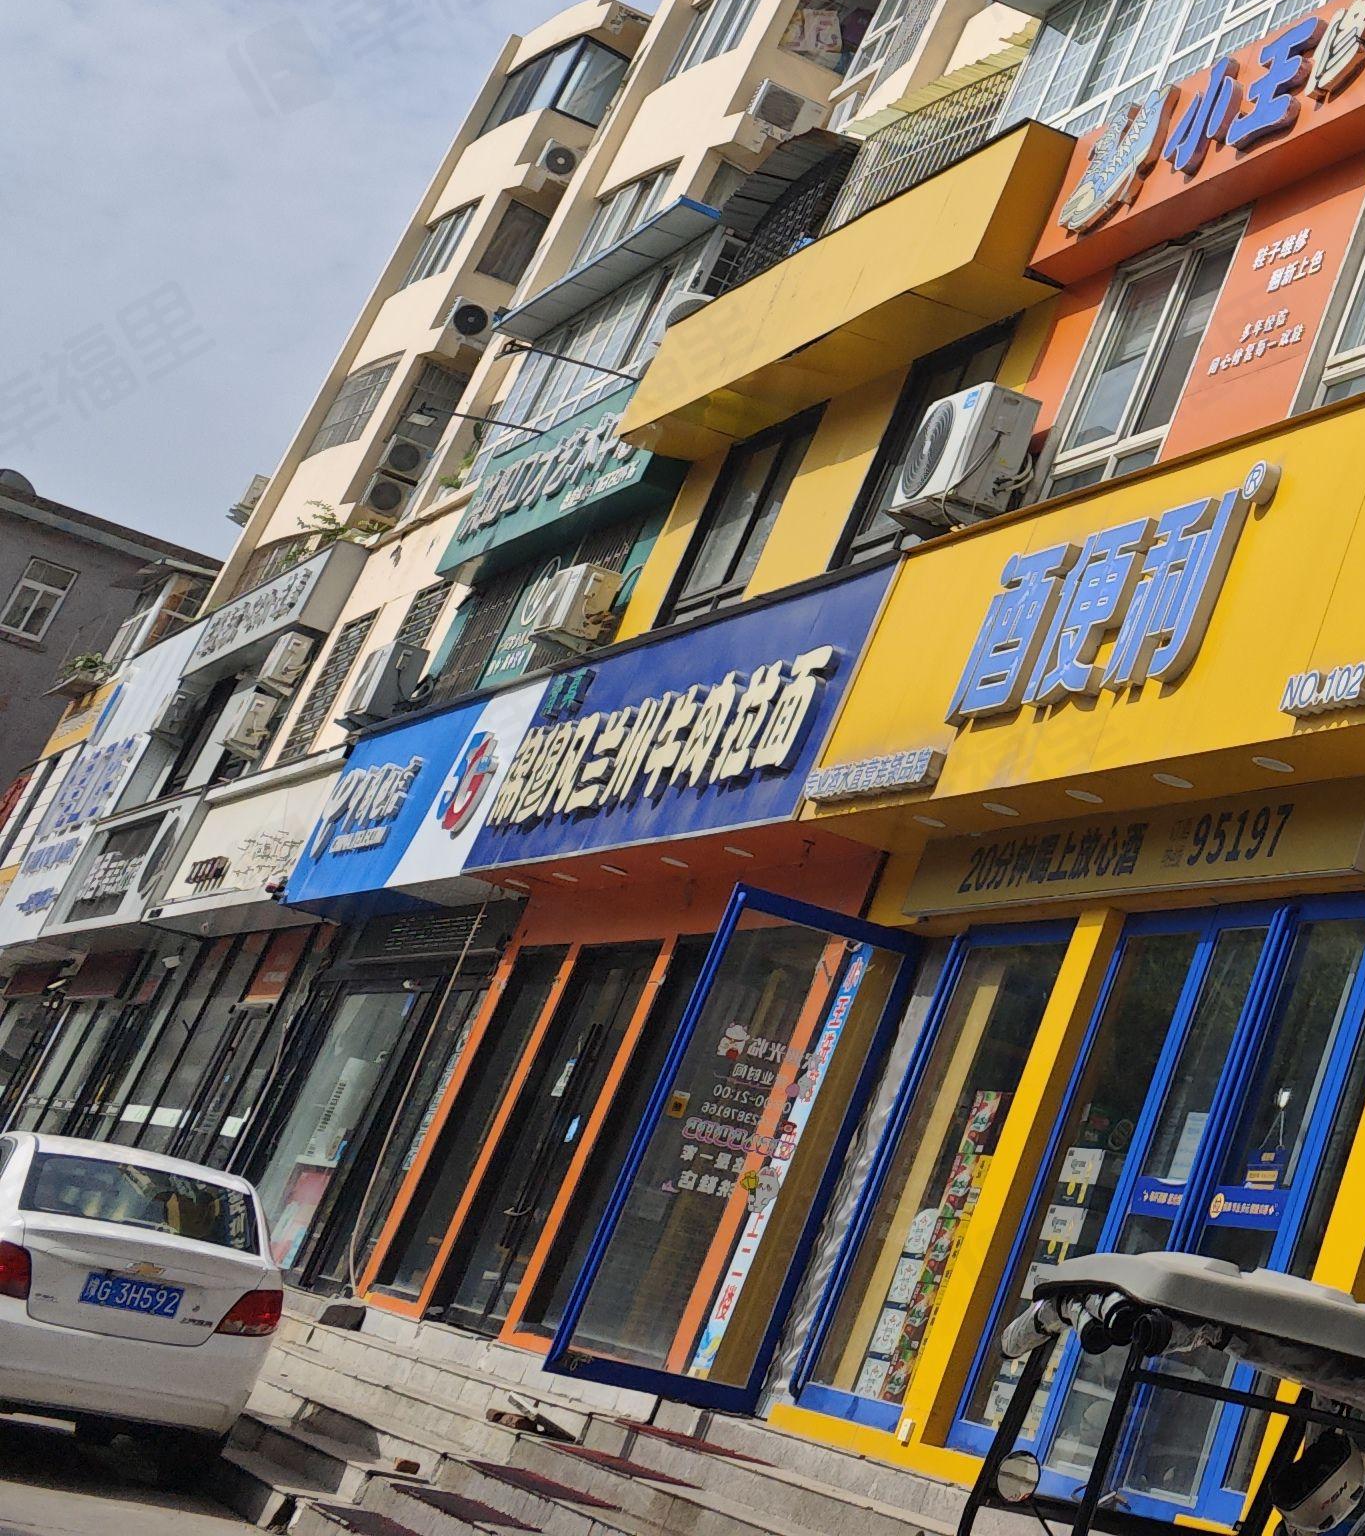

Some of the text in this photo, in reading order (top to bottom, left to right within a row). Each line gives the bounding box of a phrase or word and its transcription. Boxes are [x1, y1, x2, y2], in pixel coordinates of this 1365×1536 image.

[945, 487, 1242, 726] 酒便利
[1187, 803, 1296, 866] 95197
